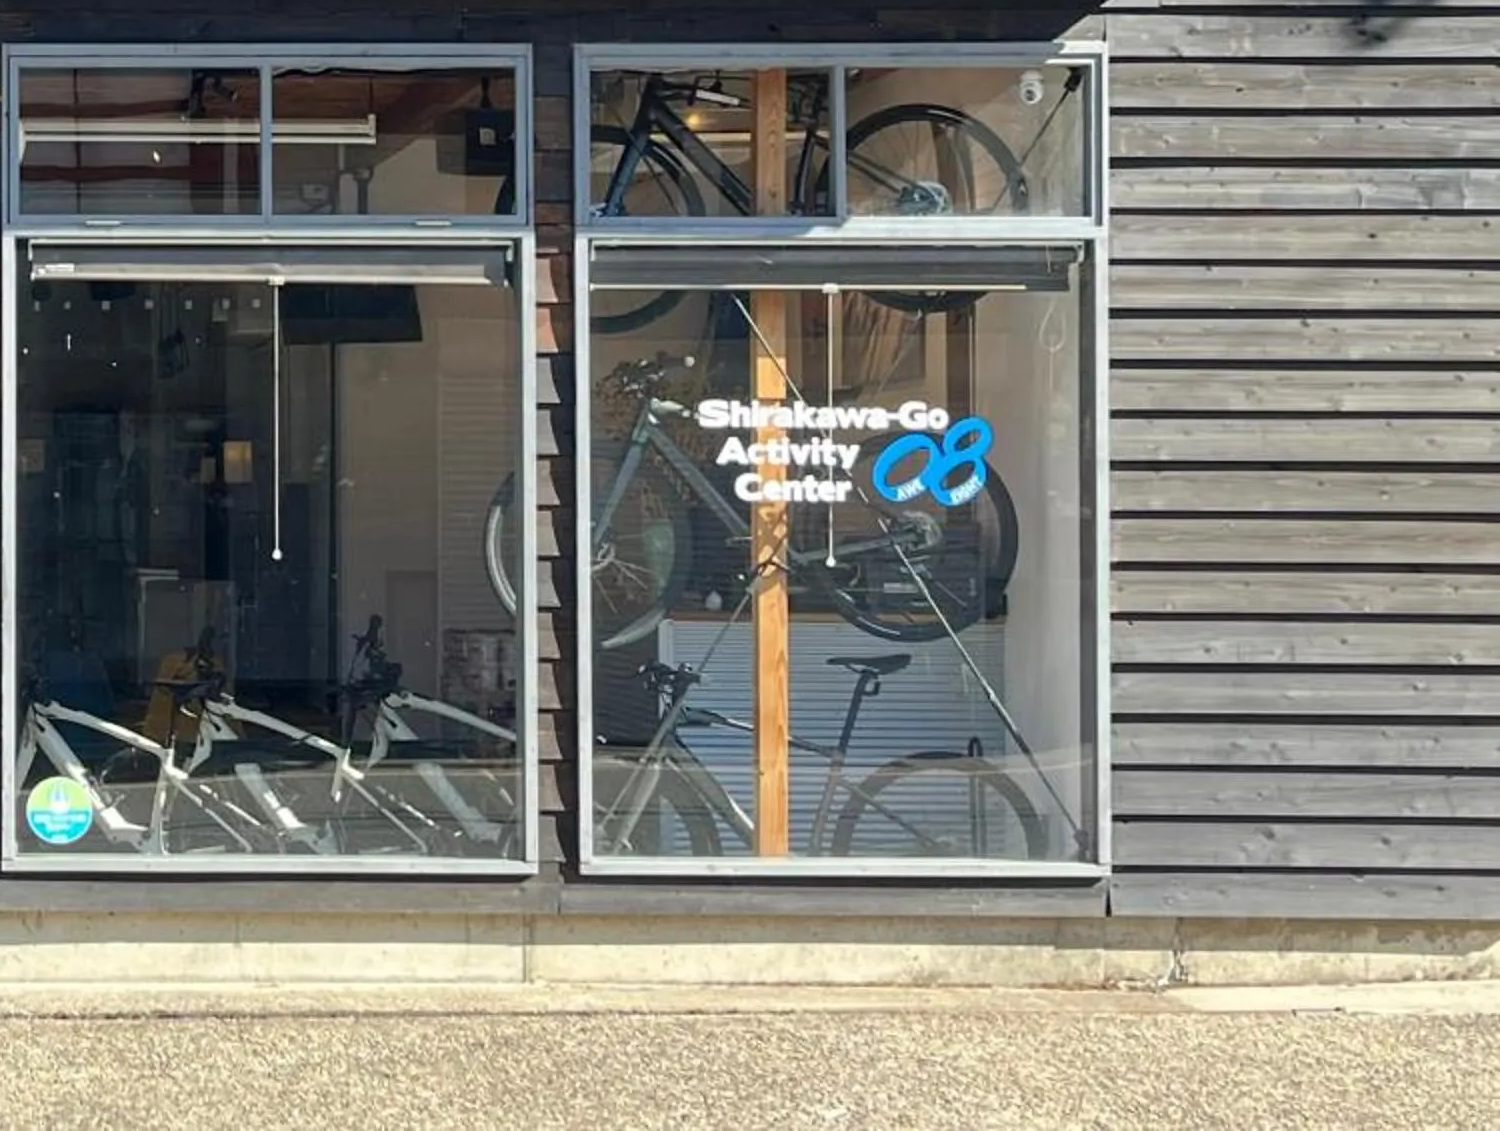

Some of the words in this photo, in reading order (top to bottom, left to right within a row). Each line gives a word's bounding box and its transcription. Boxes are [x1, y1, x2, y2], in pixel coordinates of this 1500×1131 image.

[697, 398, 950, 431] Shirakawa-Go
[715, 436, 860, 469] Activity
[733, 472, 853, 503] Center
